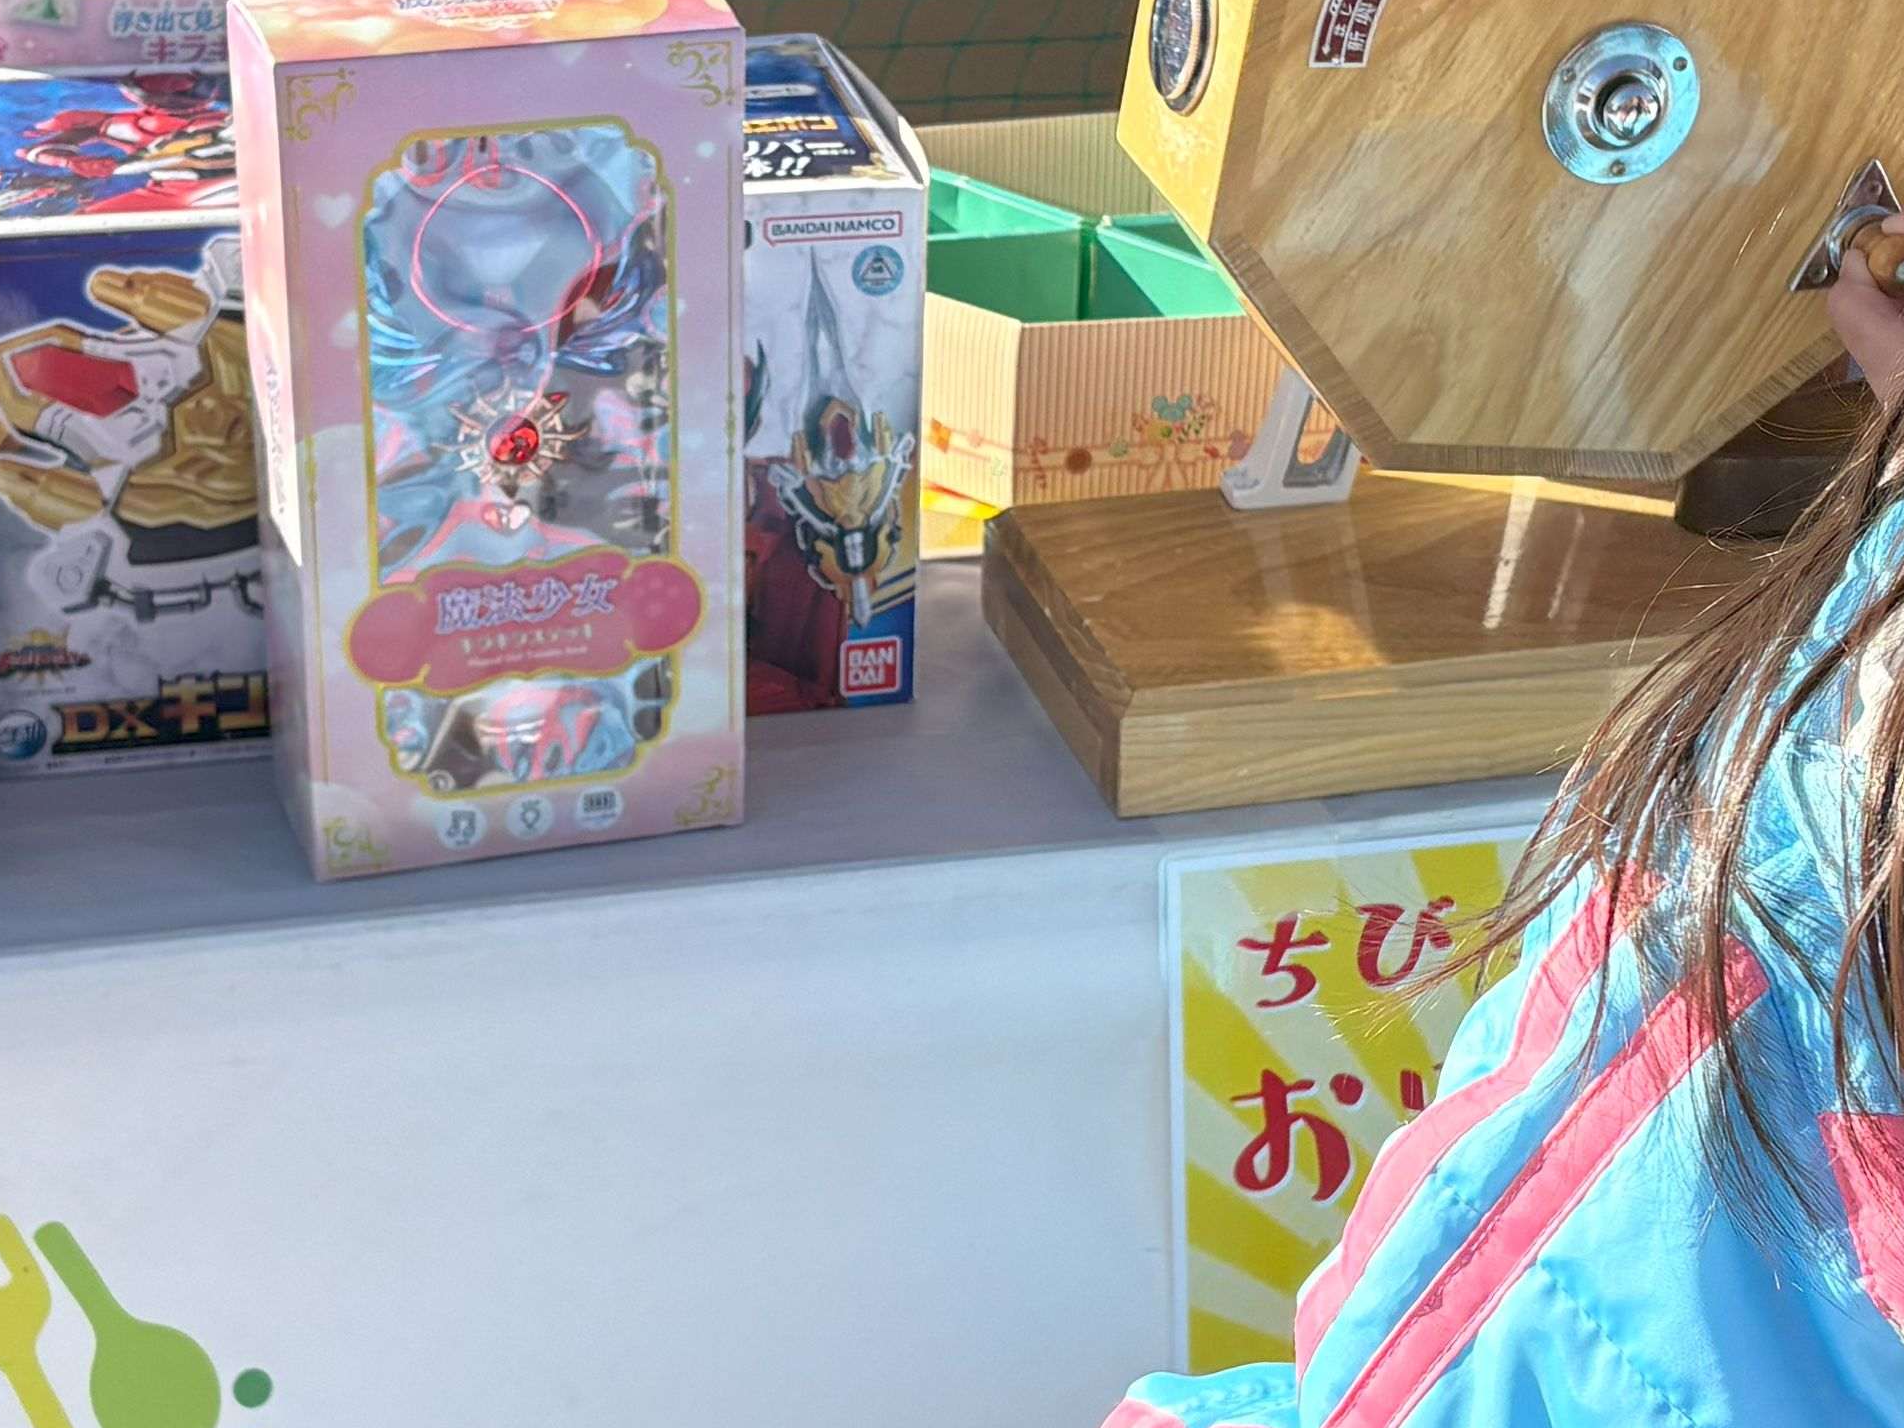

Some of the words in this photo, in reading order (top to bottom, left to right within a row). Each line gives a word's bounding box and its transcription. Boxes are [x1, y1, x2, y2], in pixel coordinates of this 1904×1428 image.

[772, 222, 831, 238] BANDAI
[834, 217, 896, 234] NAMCO
[436, 574, 618, 635] 魔法少女
[849, 647, 894, 670] BAN
[849, 665, 885, 687] DAI
